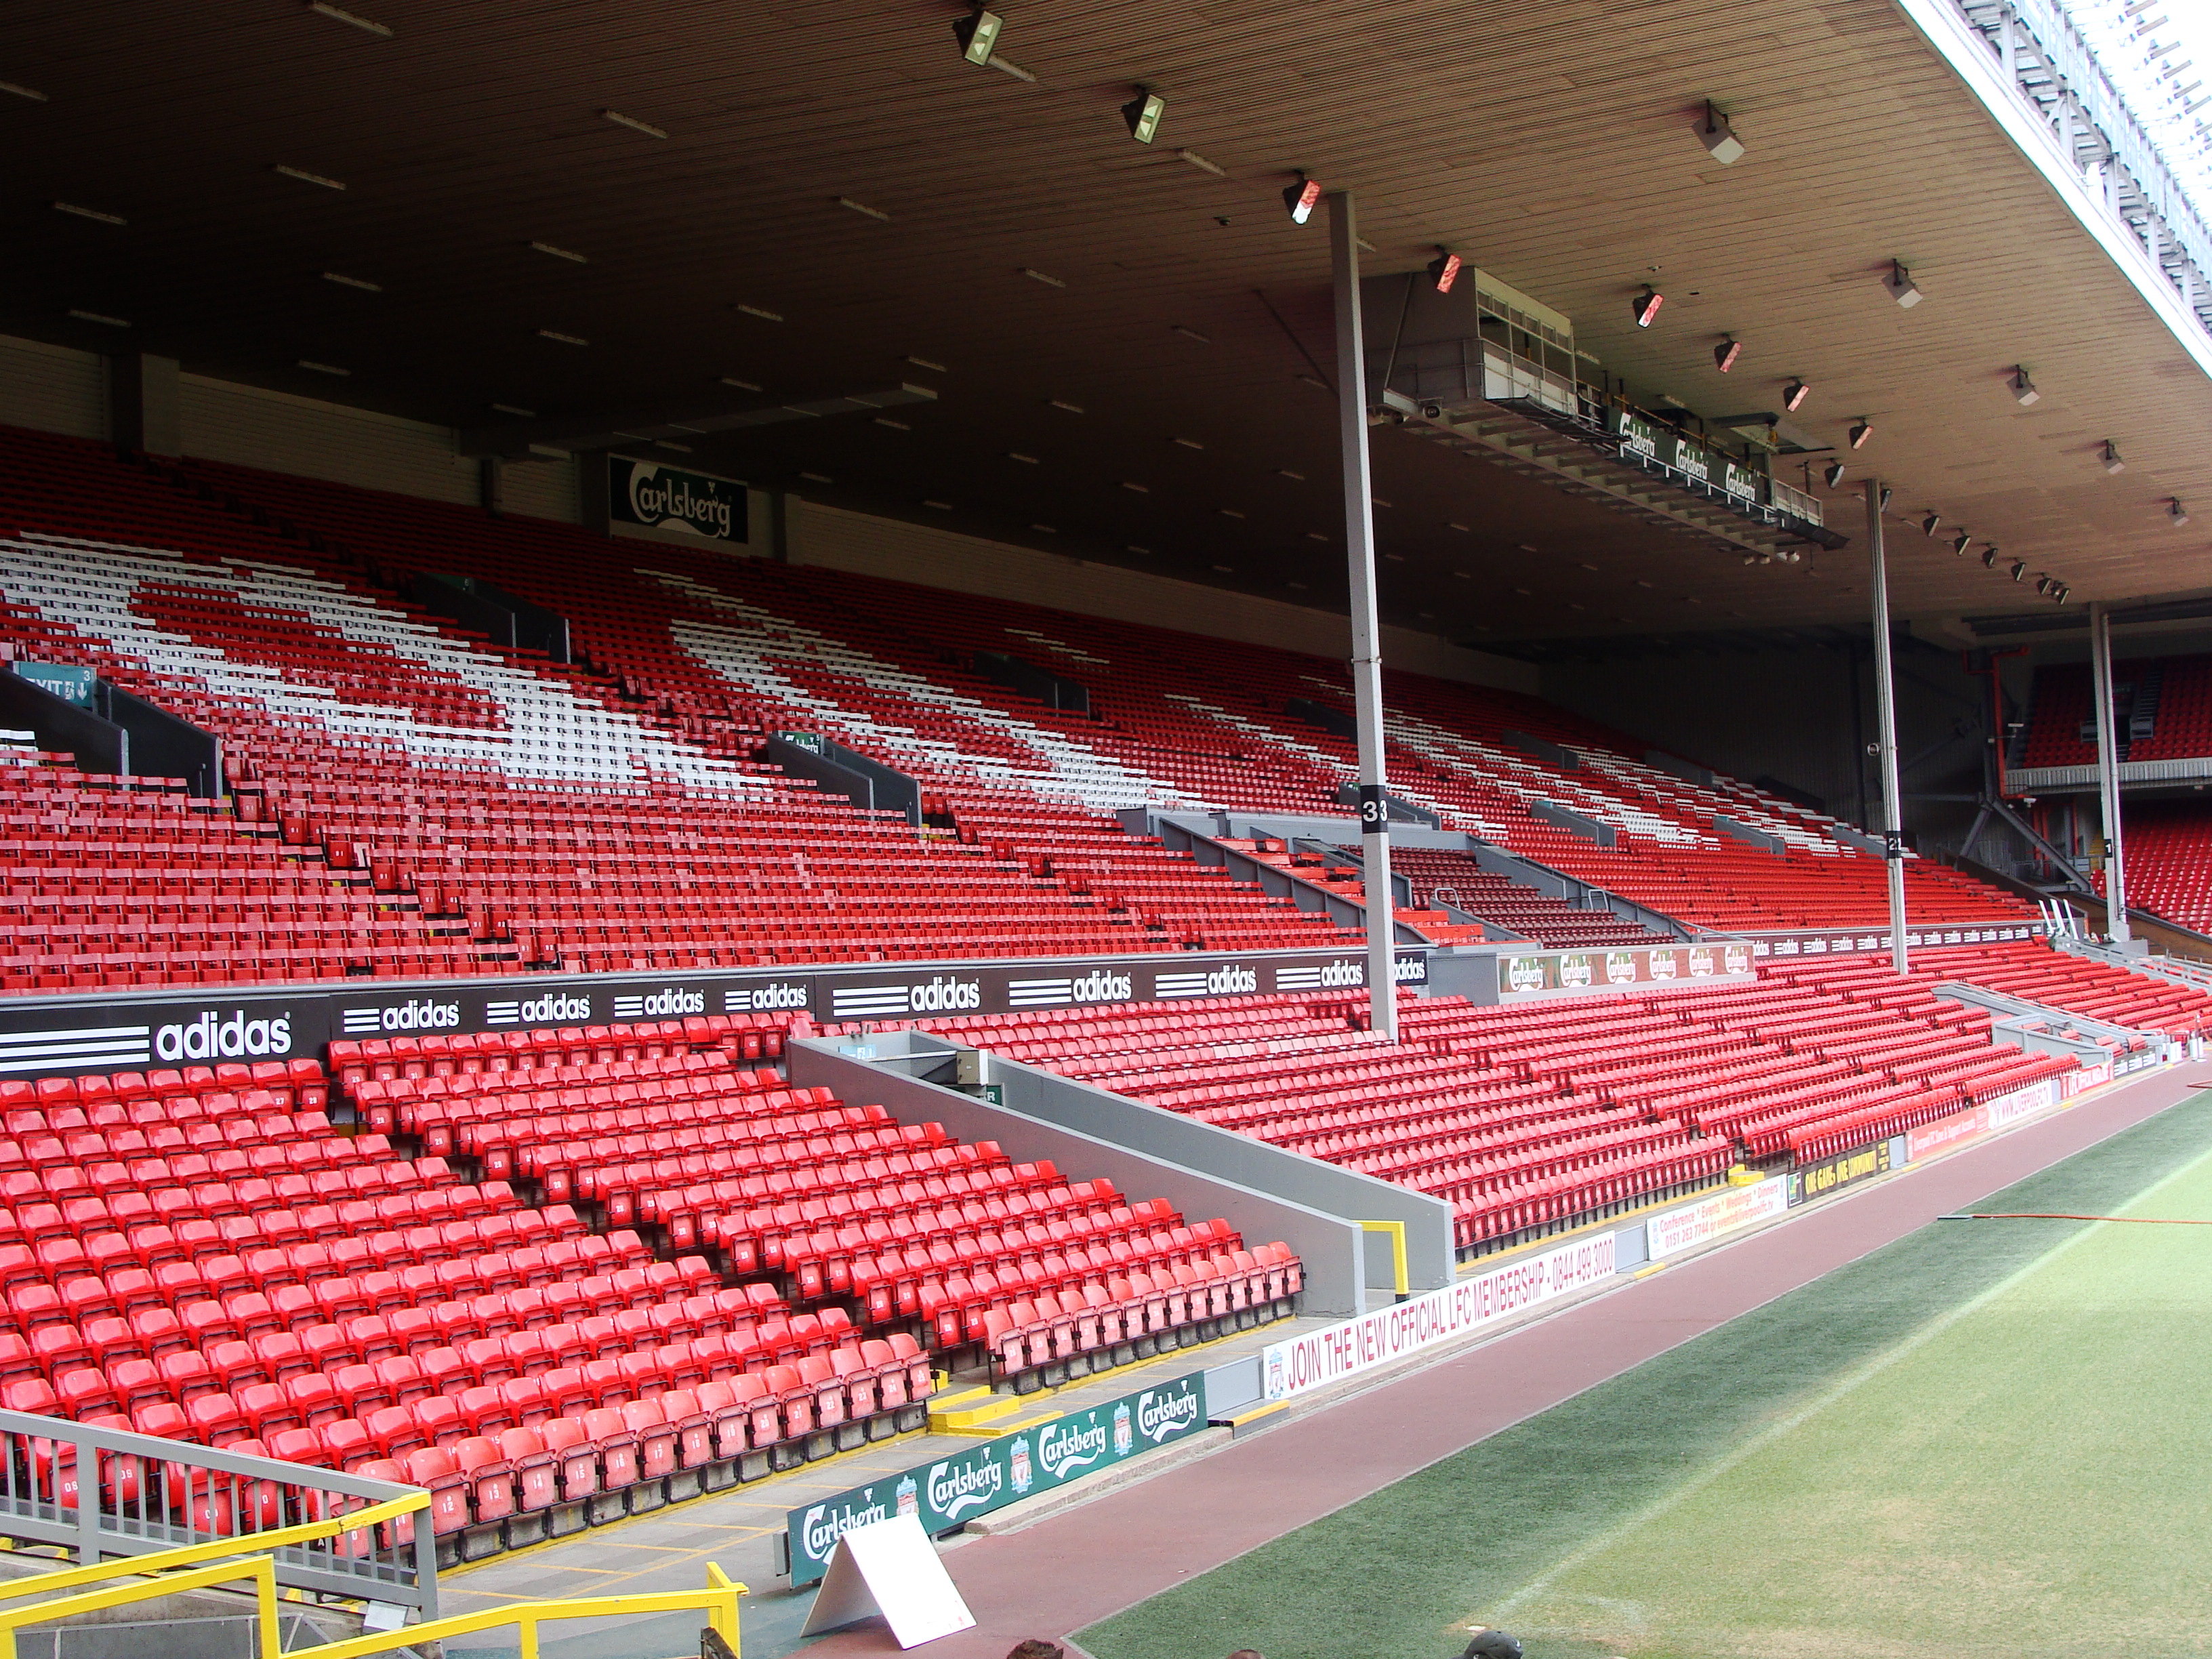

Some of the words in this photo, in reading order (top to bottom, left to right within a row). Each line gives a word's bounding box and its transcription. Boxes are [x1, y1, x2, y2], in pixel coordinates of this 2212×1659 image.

[629, 462, 731, 537] Carlsberg
[26, 678, 63, 696] XIT
[83, 670, 91, 681] 3
[1363, 801, 1378, 822] 3
[1380, 800, 1388, 821] 3
[2106, 844, 2111, 853] 1
[1560, 954, 1591, 986] Carlsberg
[1606, 951, 1636, 983] Carlsberg
[1650, 950, 1677, 979] Carlsberg
[1689, 947, 1714, 976] Carlsberg
[1725, 945, 1748, 974] Carlsberg
[1208, 964, 1256, 994] adidas
[1322, 959, 1363, 986] adidas
[1509, 957, 1544, 991] Carlsberg
[752, 983, 807, 1009] adidas
[911, 976, 981, 1012] adidas
[1073, 970, 1132, 1002] adidas
[521, 993, 591, 1022] adidas
[644, 987, 705, 1015] adidas
[383, 1002, 459, 1030] adidas
[156, 1010, 291, 1061] adidas
[1660, 1212, 1695, 1233] Conference
[1701, 1202, 1720, 1218] Events
[1725, 1191, 1752, 1210] Weddings
[1758, 1183, 1778, 1198] Dinners
[1665, 1233, 1680, 1248] 0151
[1682, 1229, 1693, 1243] 263
[1694, 1223, 1709, 1237] 7744
[1711, 1223, 1716, 1231] or
[1288, 1337, 1322, 1390] JOIN
[1325, 1328, 1353, 1376] THE
[1357, 1316, 1386, 1366] NEW
[1391, 1296, 1446, 1353] OFFICIAL
[1450, 1286, 1471, 1330] LFC
[1474, 1261, 1545, 1321] MEMBERSHIP
[1553, 1255, 1574, 1292] 0844
[1577, 1246, 1592, 1282] 499
[1593, 1238, 1613, 1277] 3000
[888, 1384, 897, 1393] 24
[918, 1373, 926, 1382] 25
[826, 1400, 835, 1410] 22
[858, 1392, 866, 1401] 23
[760, 1418, 770, 1429] 20
[794, 1410, 802, 1419] 21
[1138, 1391, 1197, 1437] Carlsberg
[693, 1439, 700, 1449] 18
[728, 1429, 735, 1438] 19
[655, 1449, 663, 1458] 17
[1038, 1424, 1106, 1472] Carlsberg
[576, 1469, 586, 1480] 15
[616, 1458, 625, 1468] 16
[489, 1490, 499, 1499] 13
[533, 1479, 543, 1489] 14
[928, 1460, 1003, 1513] Carlsberg
[443, 1502, 454, 1513] 12
[318, 1536, 328, 1547] A
